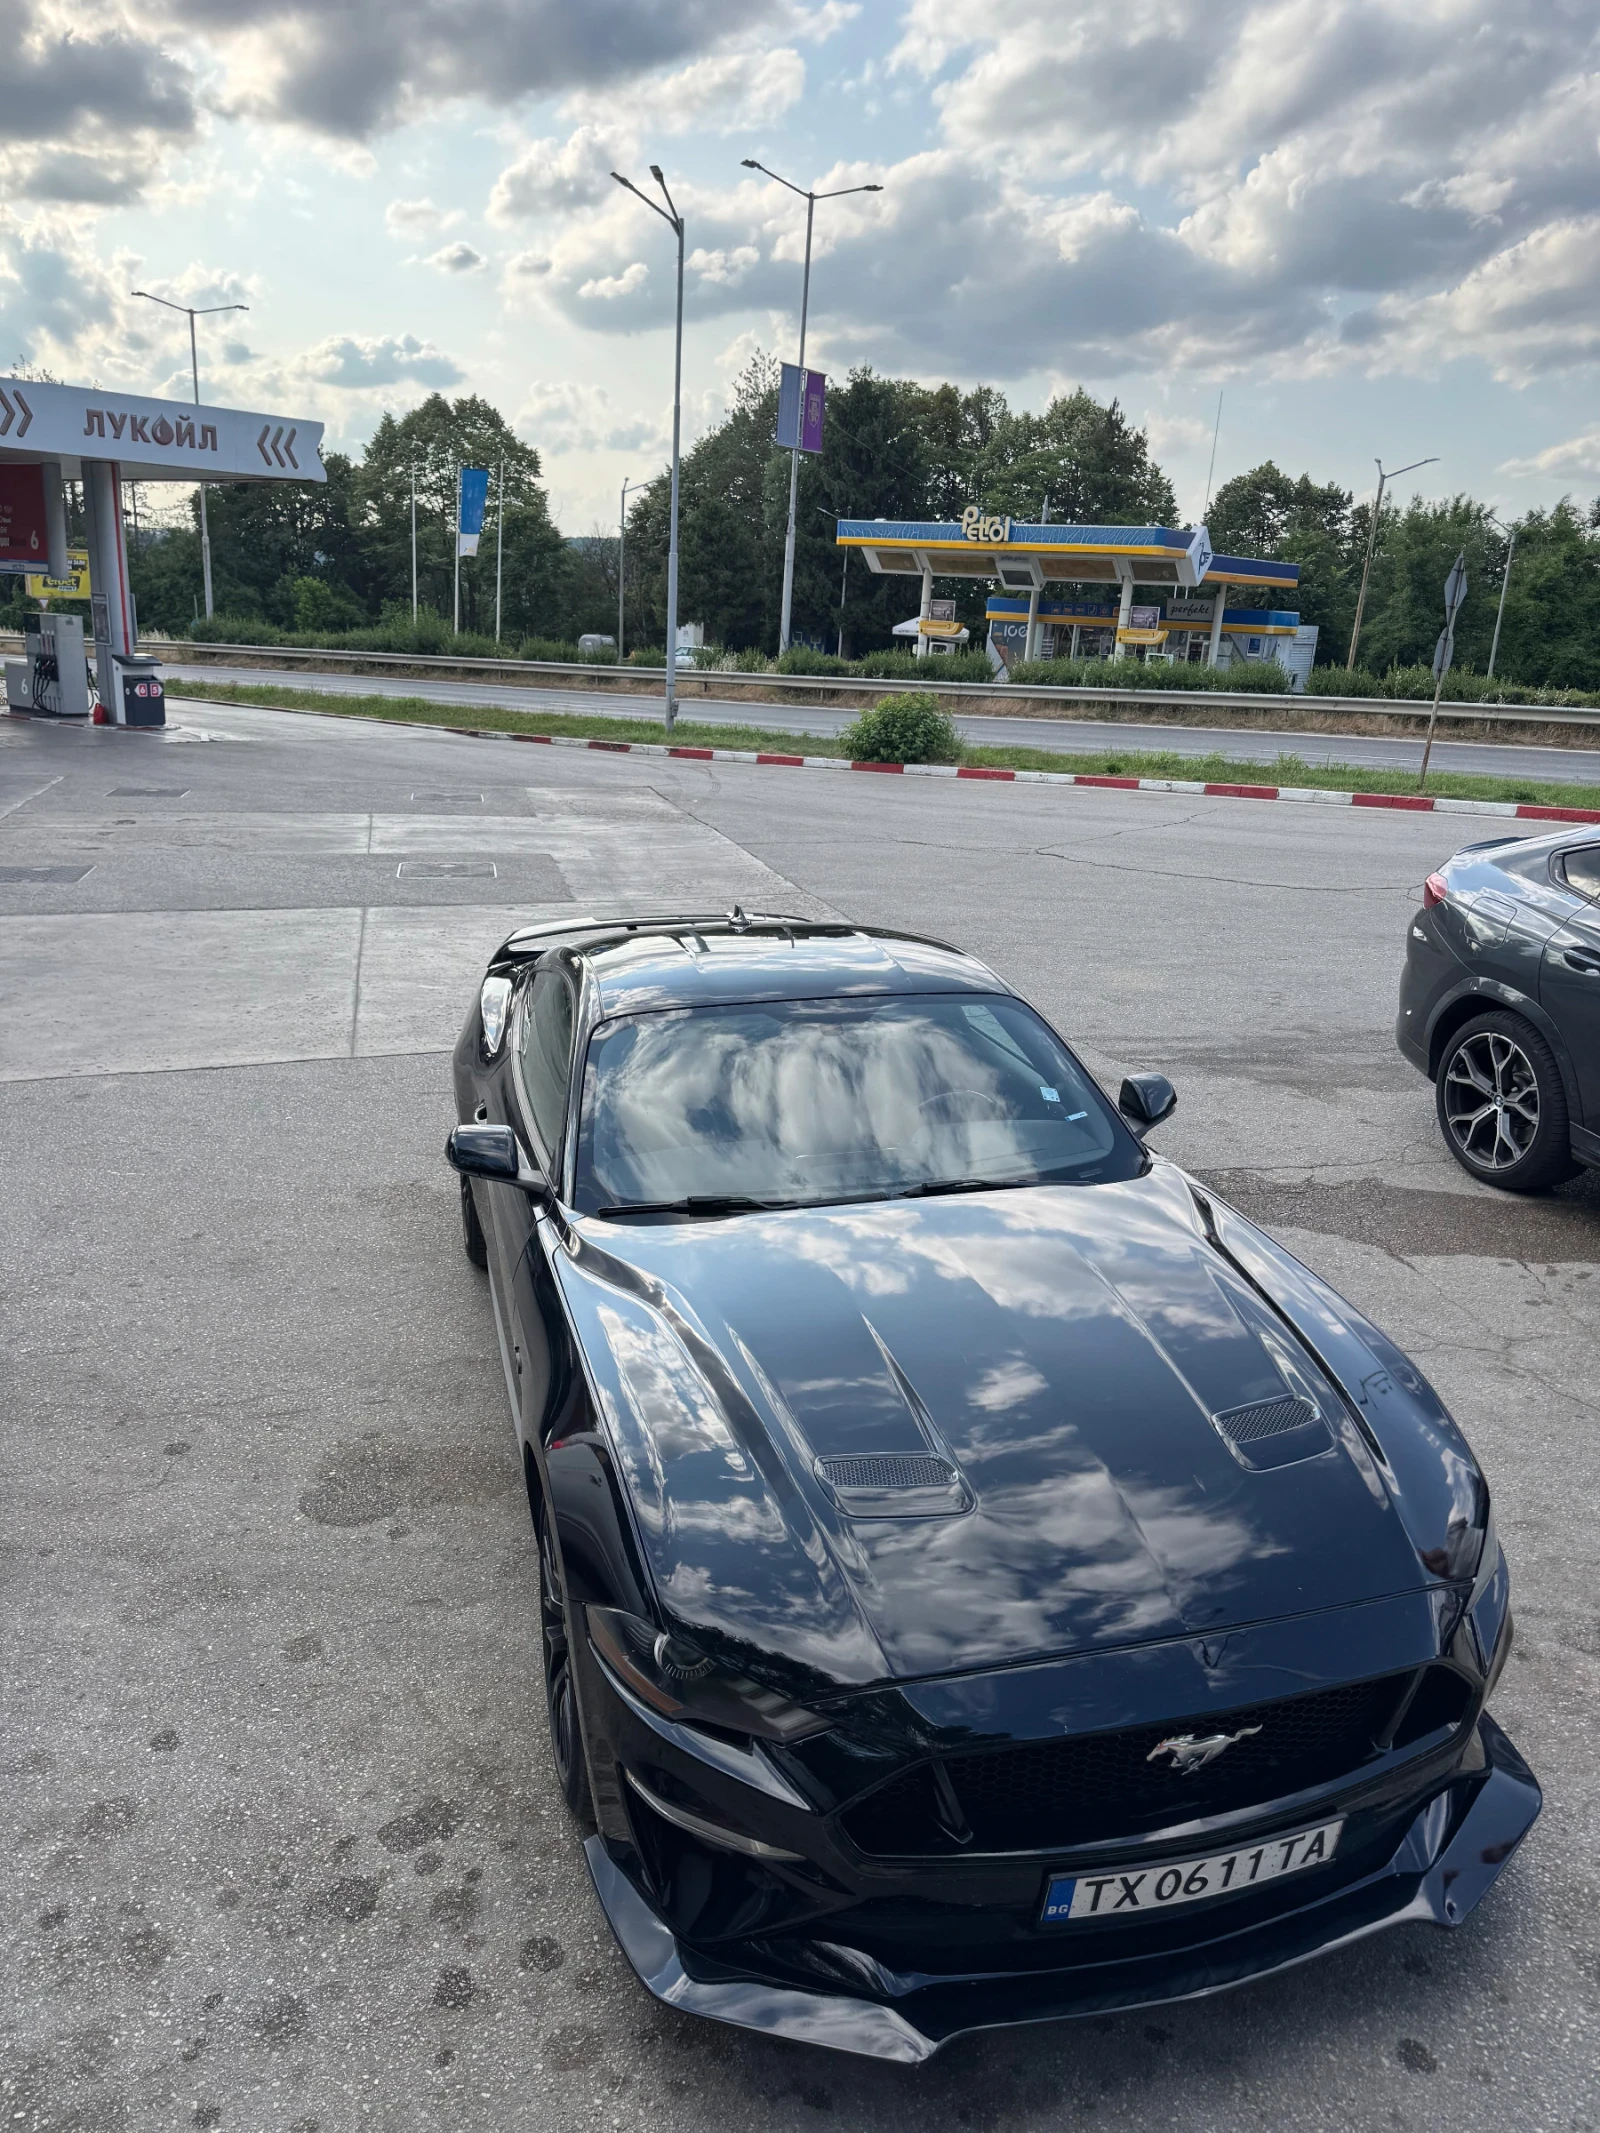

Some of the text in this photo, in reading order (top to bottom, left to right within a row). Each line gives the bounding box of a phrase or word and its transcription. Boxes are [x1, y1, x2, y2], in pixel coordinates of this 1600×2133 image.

[83, 408, 218, 452] ЛУКОЙЛ
[962, 505, 1011, 542] Petrol
[30, 530, 39, 550] 6
[1170, 603, 1210, 617] perfekt
[21, 678, 29, 695] 6
[139, 686, 146, 694] 6
[152, 686, 158, 694] 5
[1085, 1830, 1325, 1912] TX 0611 TA
[1047, 1904, 1069, 1915] BG
